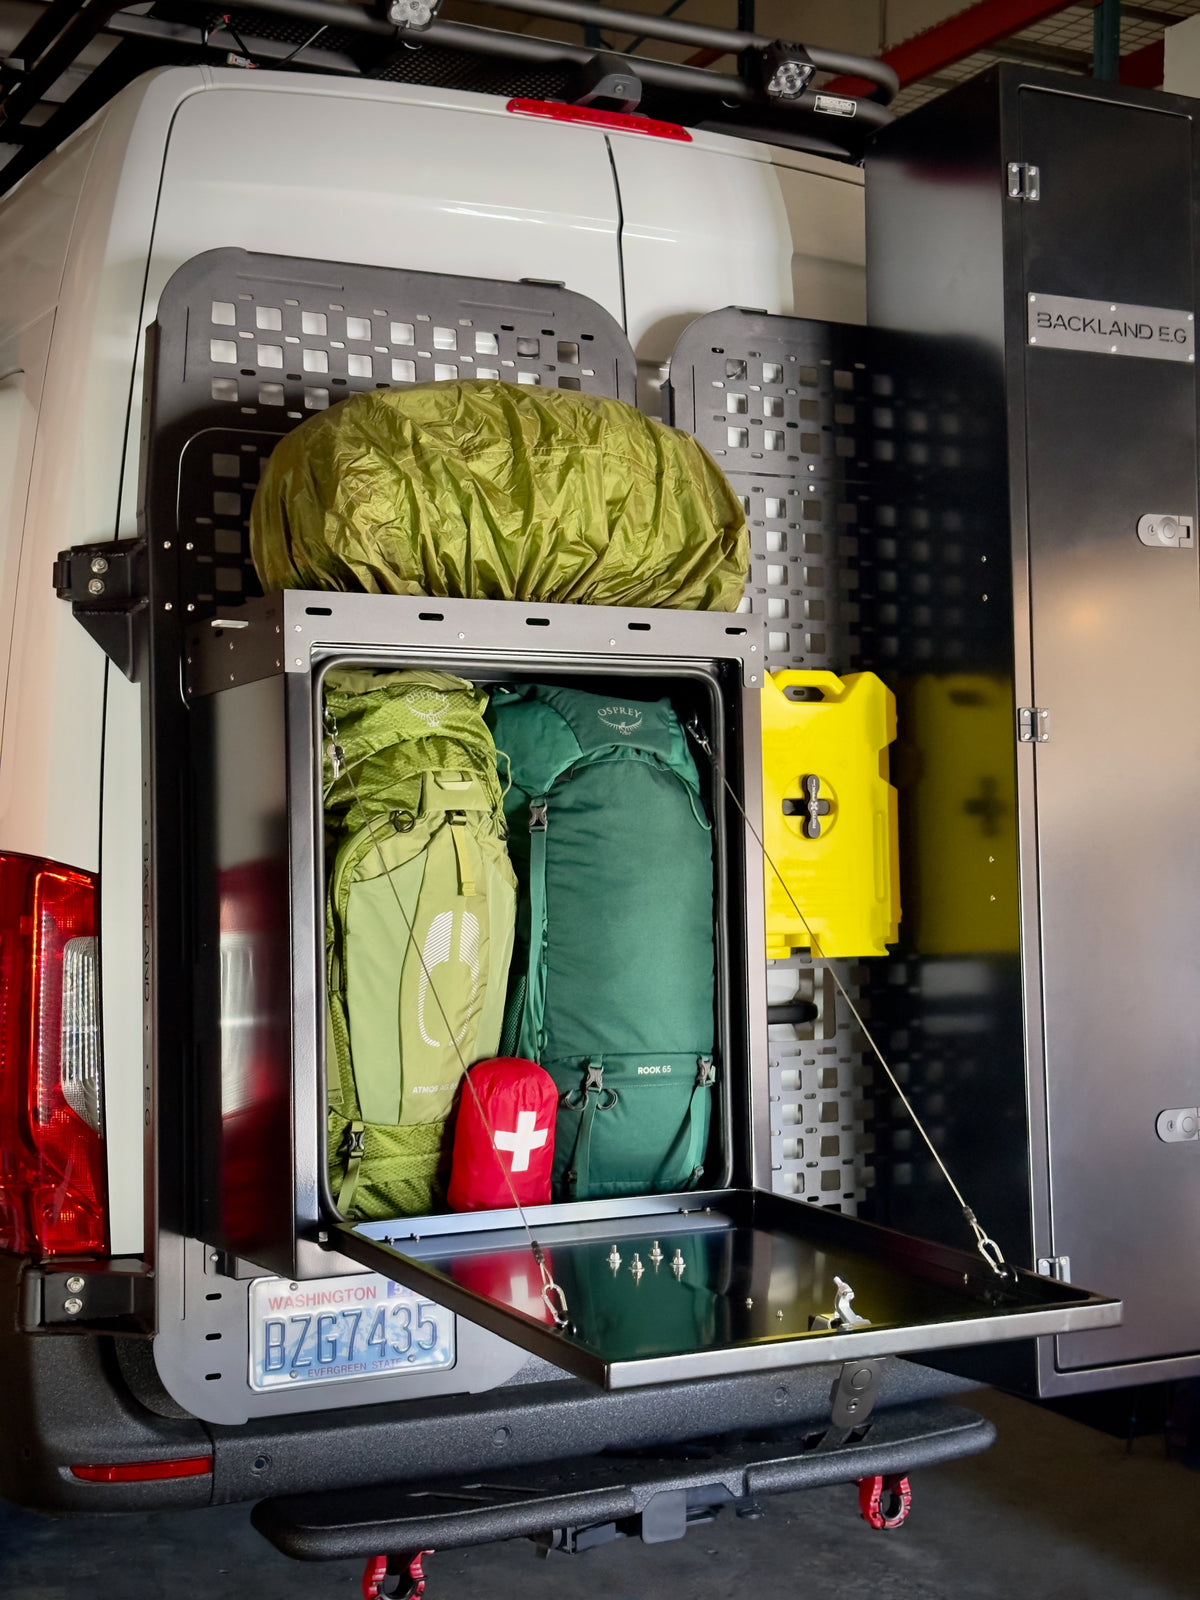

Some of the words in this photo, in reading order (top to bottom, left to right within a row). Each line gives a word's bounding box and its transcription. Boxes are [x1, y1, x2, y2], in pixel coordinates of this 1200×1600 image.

[1037, 312, 1153, 340] BACKLAND
[597, 706, 642, 718] OSPREY
[637, 1065, 661, 1075] ROOK
[662, 1064, 672, 1073] 65
[412, 1085, 439, 1094] ATMOS
[268, 1286, 377, 1311] WASHINGTON
[264, 1302, 439, 1371] BZG7435
[307, 1362, 367, 1378] EVERGREEN
